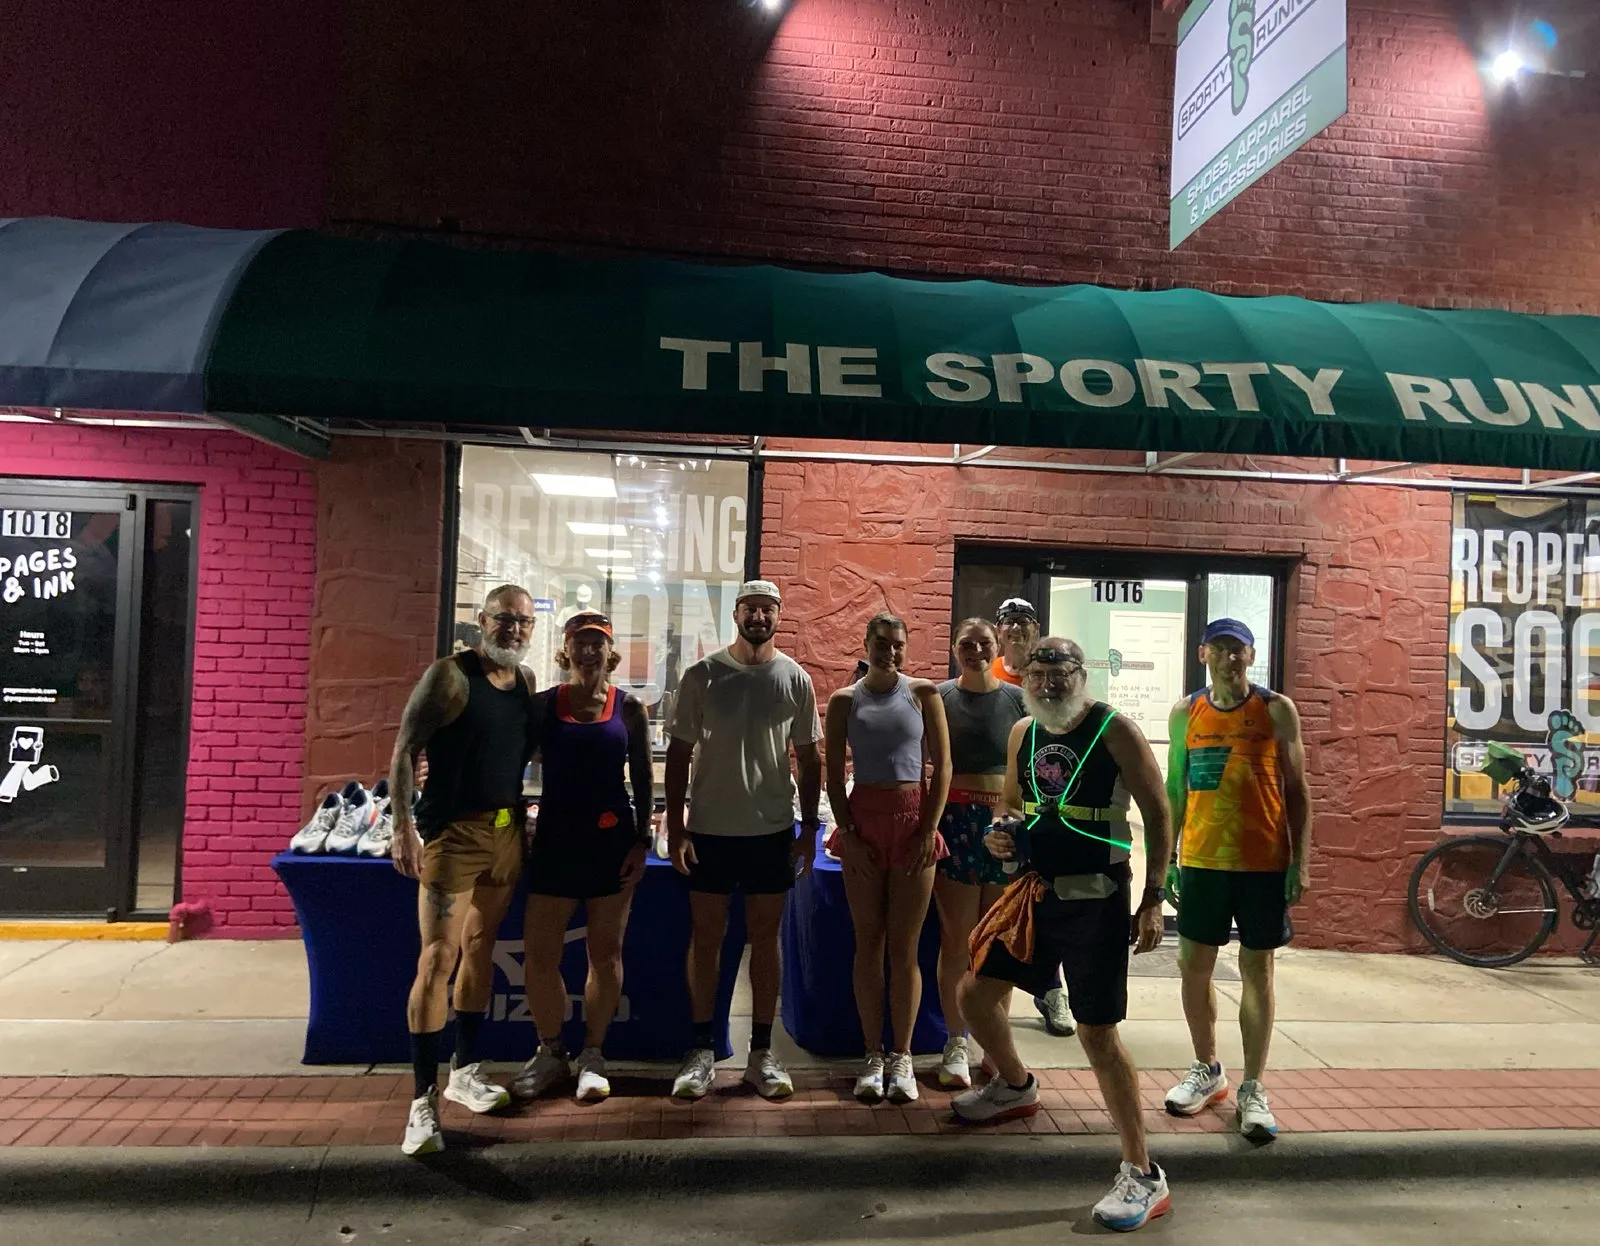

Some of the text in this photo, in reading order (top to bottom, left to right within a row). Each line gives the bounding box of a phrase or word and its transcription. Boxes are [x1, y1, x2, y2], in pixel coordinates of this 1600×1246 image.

[1181, 63, 1229, 129] SPORTY
[1187, 84, 1312, 206] SHOES, APPAREL
[1190, 113, 1307, 225] & ACCESSORIES
[660, 336, 1600, 431] THE SPORTY RUN
[6, 510, 70, 537] 1018
[0, 547, 77, 580] PAGES
[3, 571, 75, 603] & INK
[1093, 580, 1143, 603] 1016
